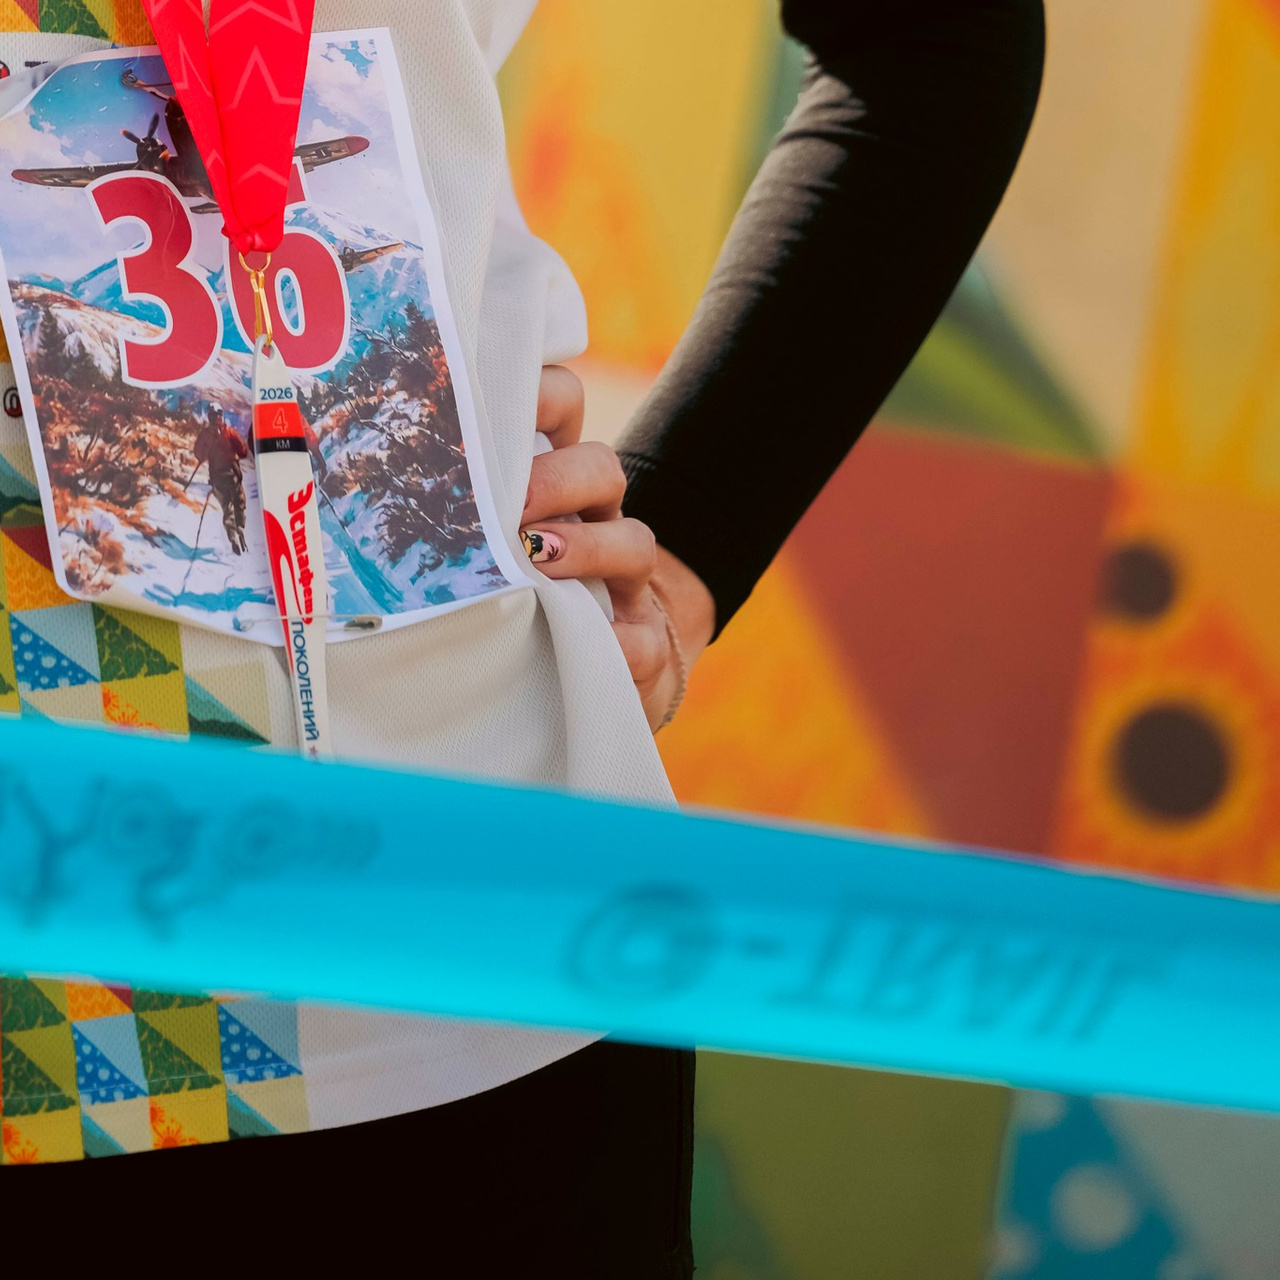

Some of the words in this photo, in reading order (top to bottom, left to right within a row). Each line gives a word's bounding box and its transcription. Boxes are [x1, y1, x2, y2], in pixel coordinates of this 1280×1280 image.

[88, 158, 348, 385] 36
[259, 387, 293, 401] 2026
[271, 406, 289, 434] 4
[291, 621, 320, 741] ПОКОЛЕНИЙ
